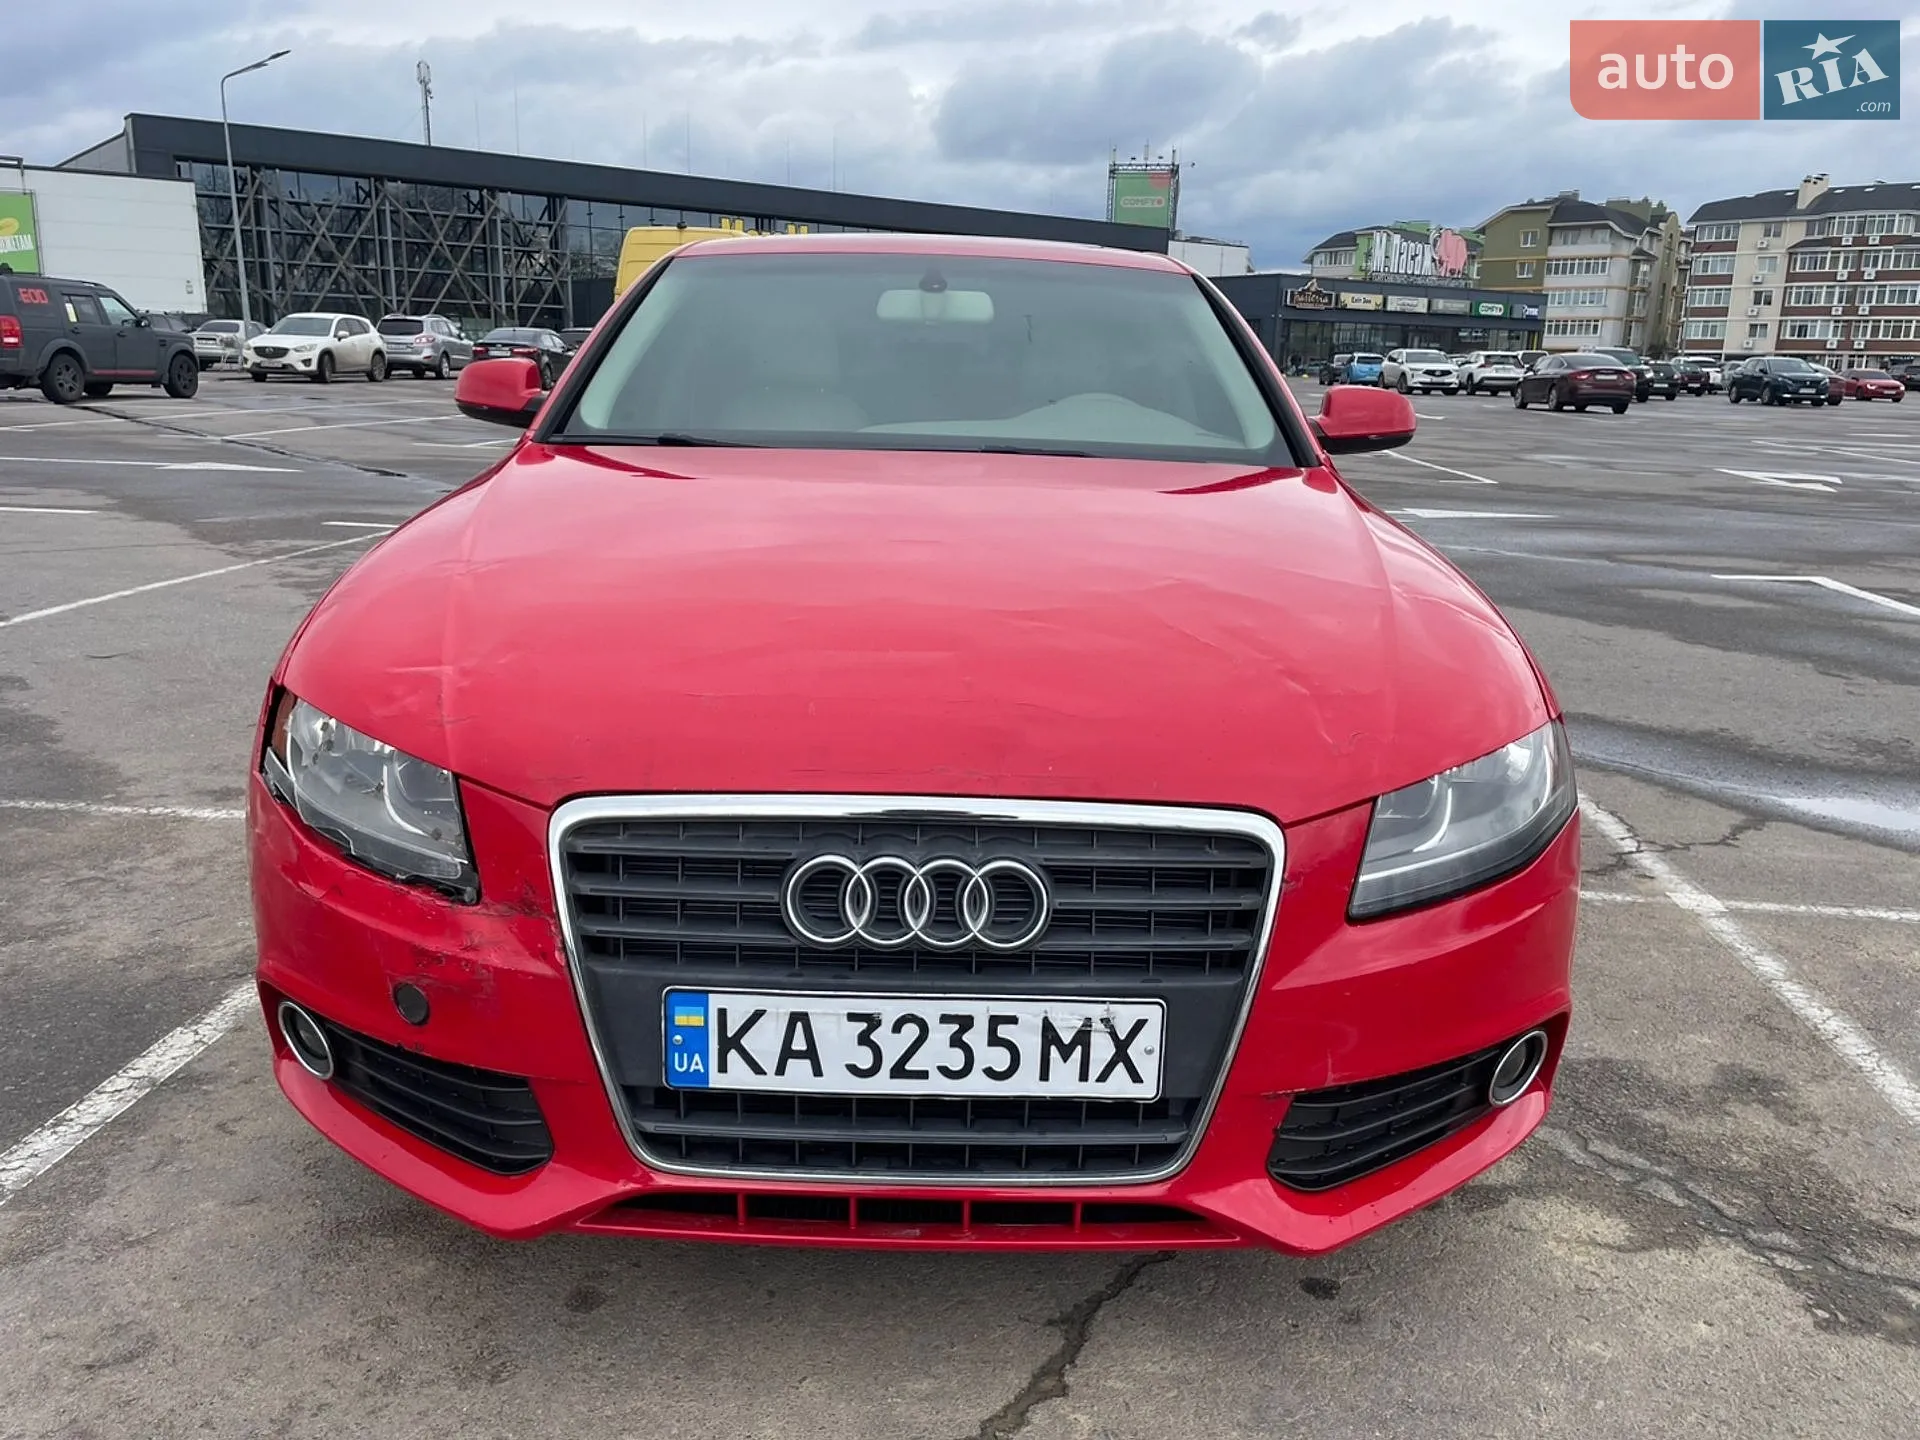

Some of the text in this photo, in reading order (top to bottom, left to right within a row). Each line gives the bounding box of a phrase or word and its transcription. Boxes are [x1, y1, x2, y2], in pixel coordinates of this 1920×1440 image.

[673, 1051, 705, 1075] UA
[716, 1007, 1149, 1084] KA 3235 MX
